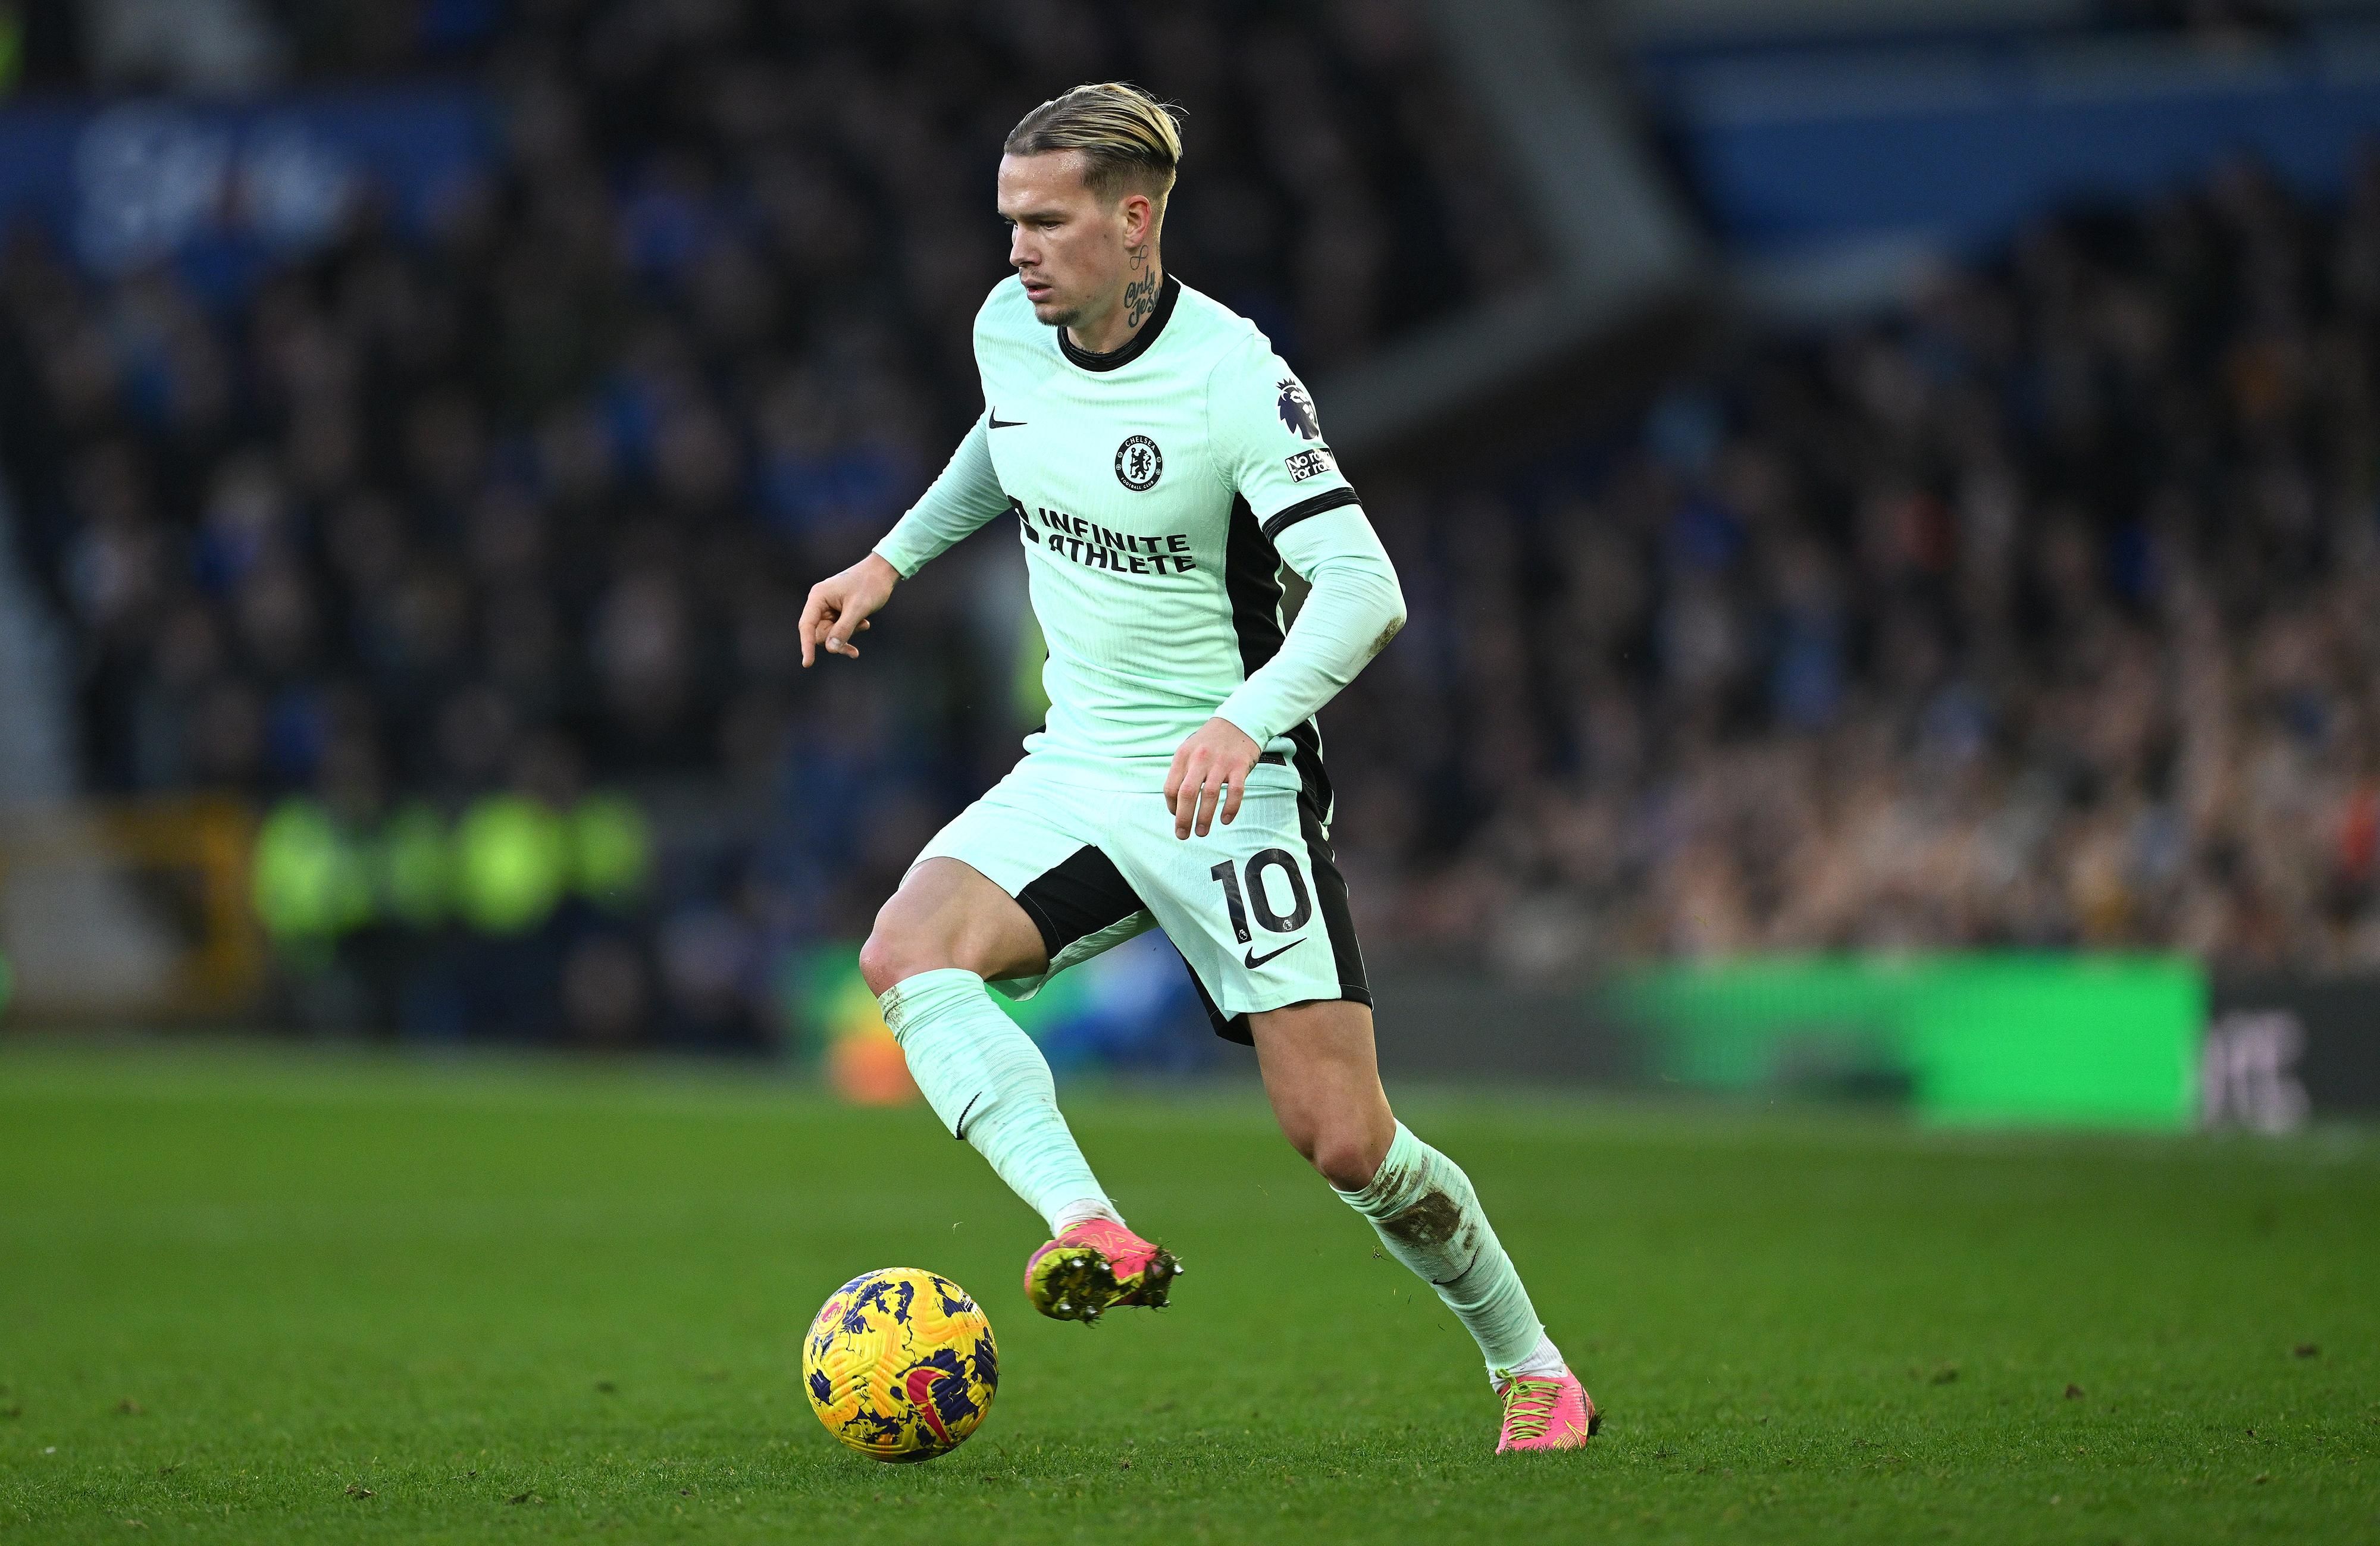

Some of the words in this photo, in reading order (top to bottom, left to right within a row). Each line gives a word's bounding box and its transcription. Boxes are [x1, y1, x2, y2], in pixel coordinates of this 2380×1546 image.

[1128, 287, 1160, 327] Jesu
[1125, 436, 1155, 450] CHELSEA
[1120, 477, 1142, 490] FOOTBALL
[1143, 480, 1154, 488] CLUB
[1285, 456, 1308, 472] No
[1039, 507, 1191, 553] INFINITE
[1048, 534, 1197, 575] ATHLETE
[1210, 848, 1312, 945] 10
